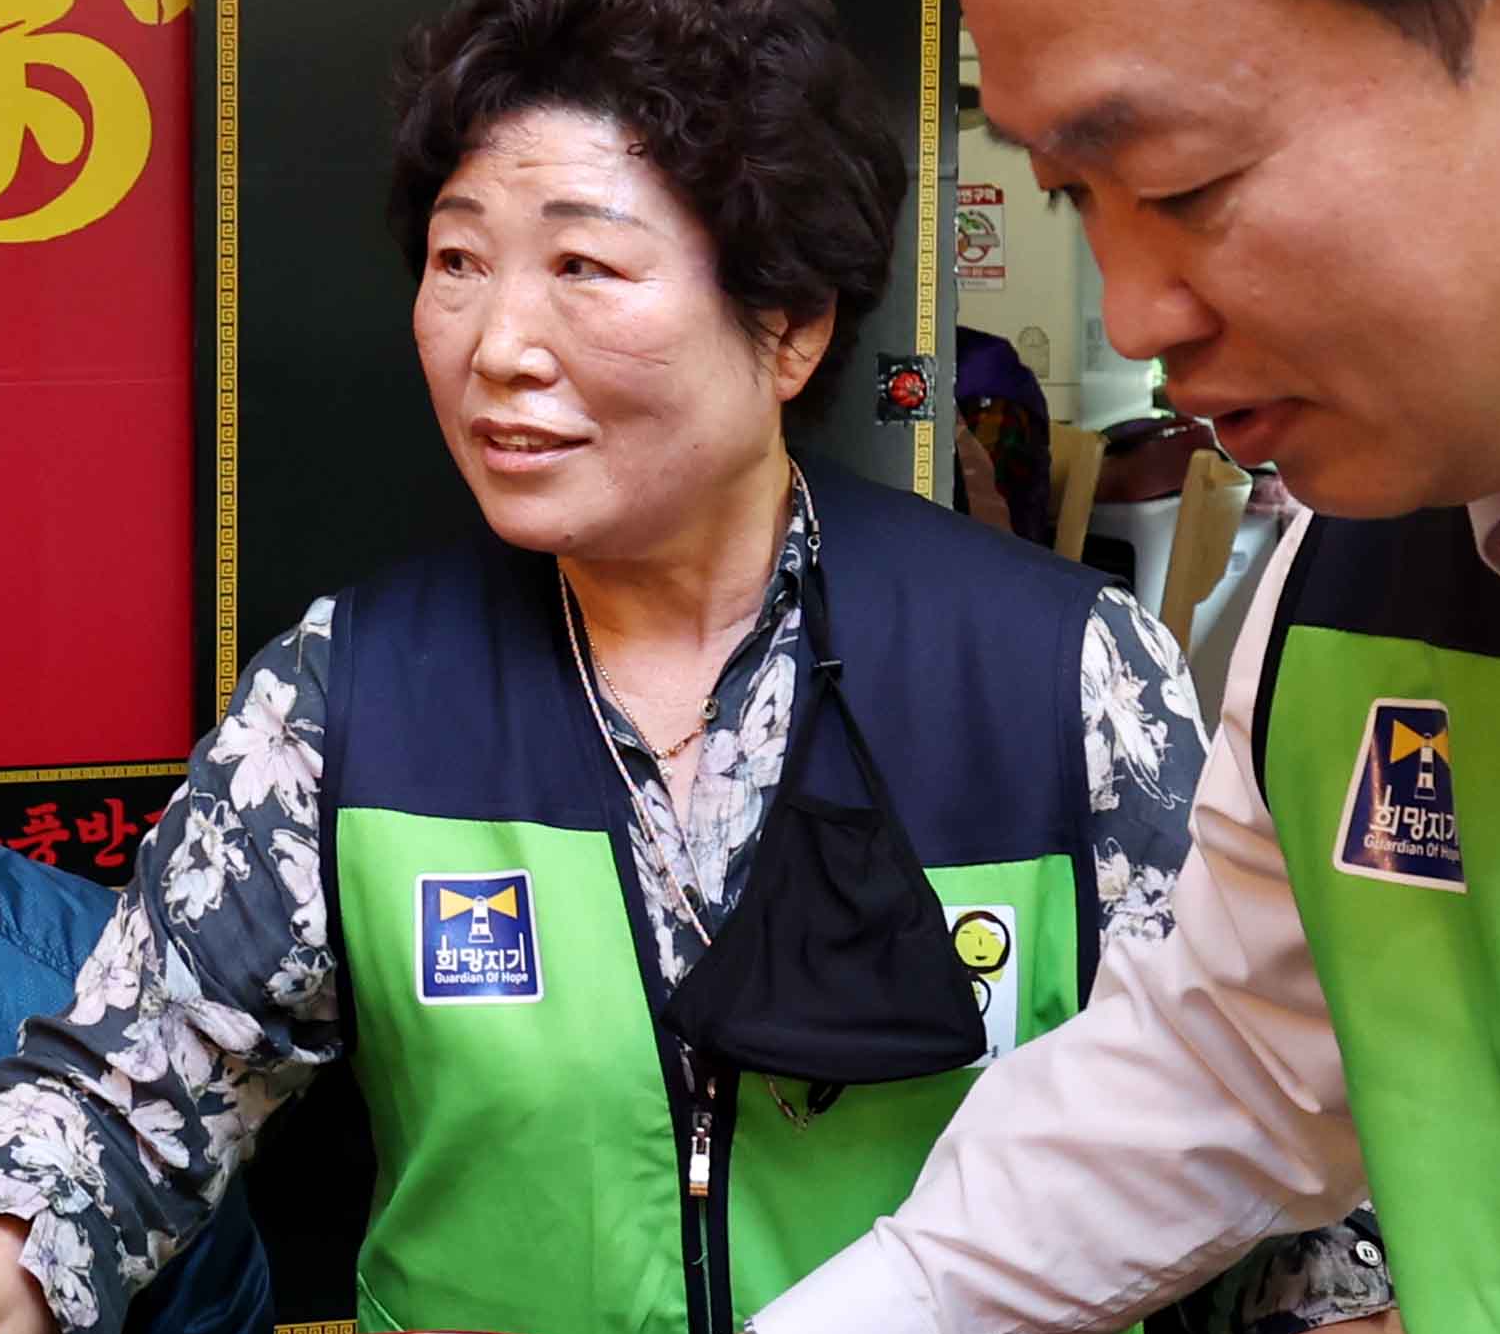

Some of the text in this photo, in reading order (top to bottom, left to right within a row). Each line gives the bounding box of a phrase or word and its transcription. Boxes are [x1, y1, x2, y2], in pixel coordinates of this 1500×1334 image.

[1363, 833, 1424, 856] Guardian
[435, 932, 527, 973] 희망지기
[434, 971, 528, 986] Guardian Of Hope
